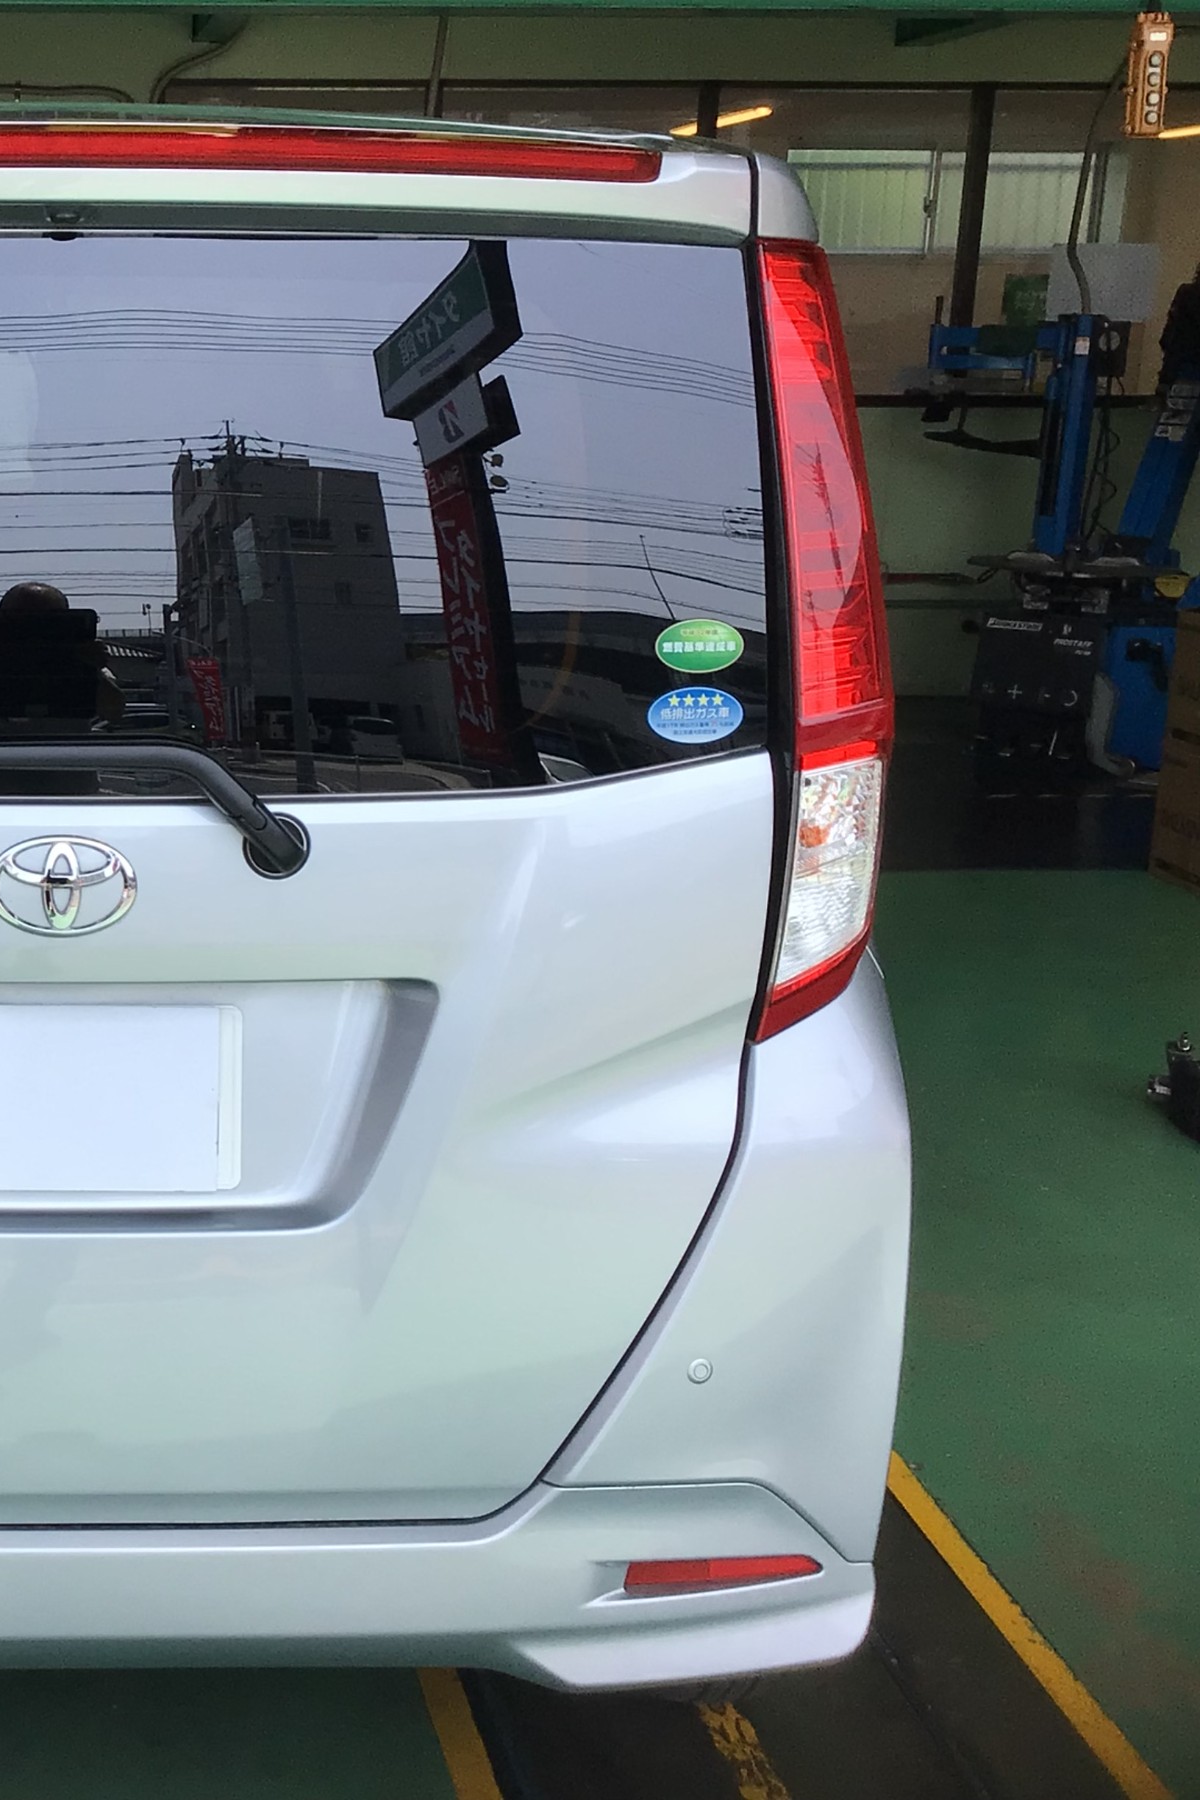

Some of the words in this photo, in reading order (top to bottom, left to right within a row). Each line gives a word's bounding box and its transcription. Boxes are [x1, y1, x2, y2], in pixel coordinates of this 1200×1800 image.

[660, 707, 731, 721] 低排出ガス車
